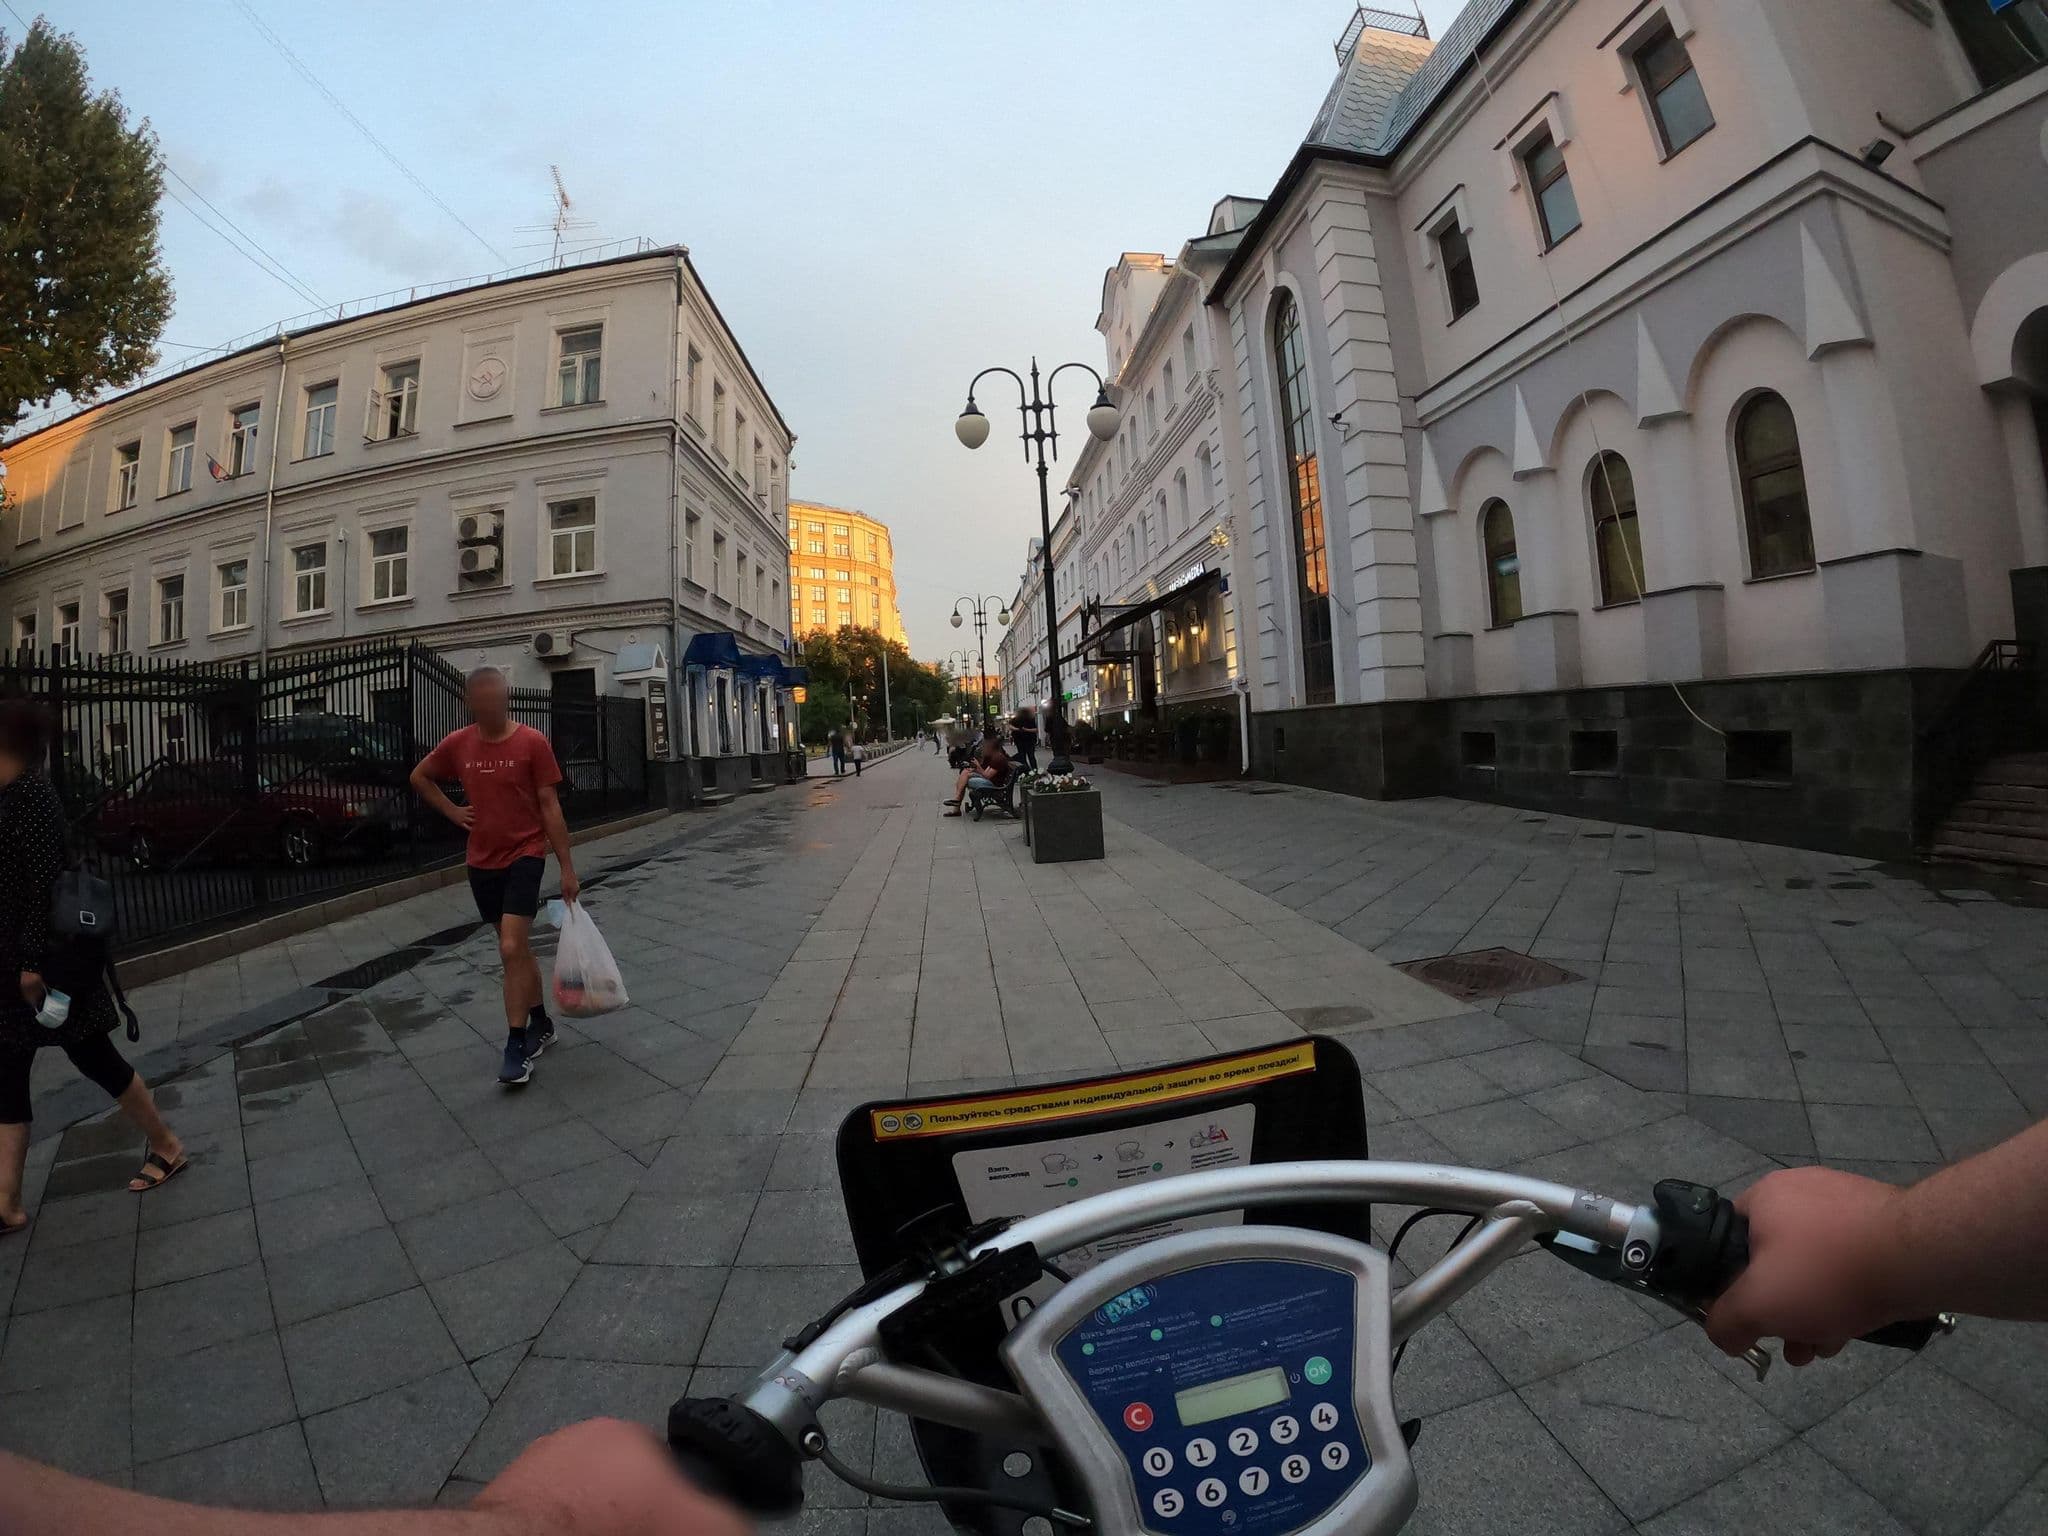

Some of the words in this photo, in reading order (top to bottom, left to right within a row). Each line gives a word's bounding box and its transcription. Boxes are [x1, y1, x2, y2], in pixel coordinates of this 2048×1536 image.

[929, 1108, 1001, 1124] Пользуйтесь
[1003, 1099, 1071, 1116] средствами
[1073, 1083, 1165, 1105] индивидуальной
[1167, 1075, 1207, 1091] защиты
[1209, 1072, 1221, 1082] во
[1223, 1066, 1256, 1081] время
[1257, 1054, 1300, 1071] поездки!
[1308, 1365, 1328, 1378] OK
[1131, 1408, 1145, 1425] C
[1150, 1452, 1166, 1472] 0
[1193, 1443, 1209, 1462] 1
[1236, 1432, 1253, 1451] 2
[1277, 1419, 1292, 1438] 3
[1317, 1408, 1332, 1425] 4
[1161, 1492, 1177, 1512] 5
[1204, 1483, 1220, 1502] 6
[1246, 1471, 1260, 1490] 7
[1287, 1459, 1304, 1478] 8
[1327, 1446, 1342, 1464] 9
